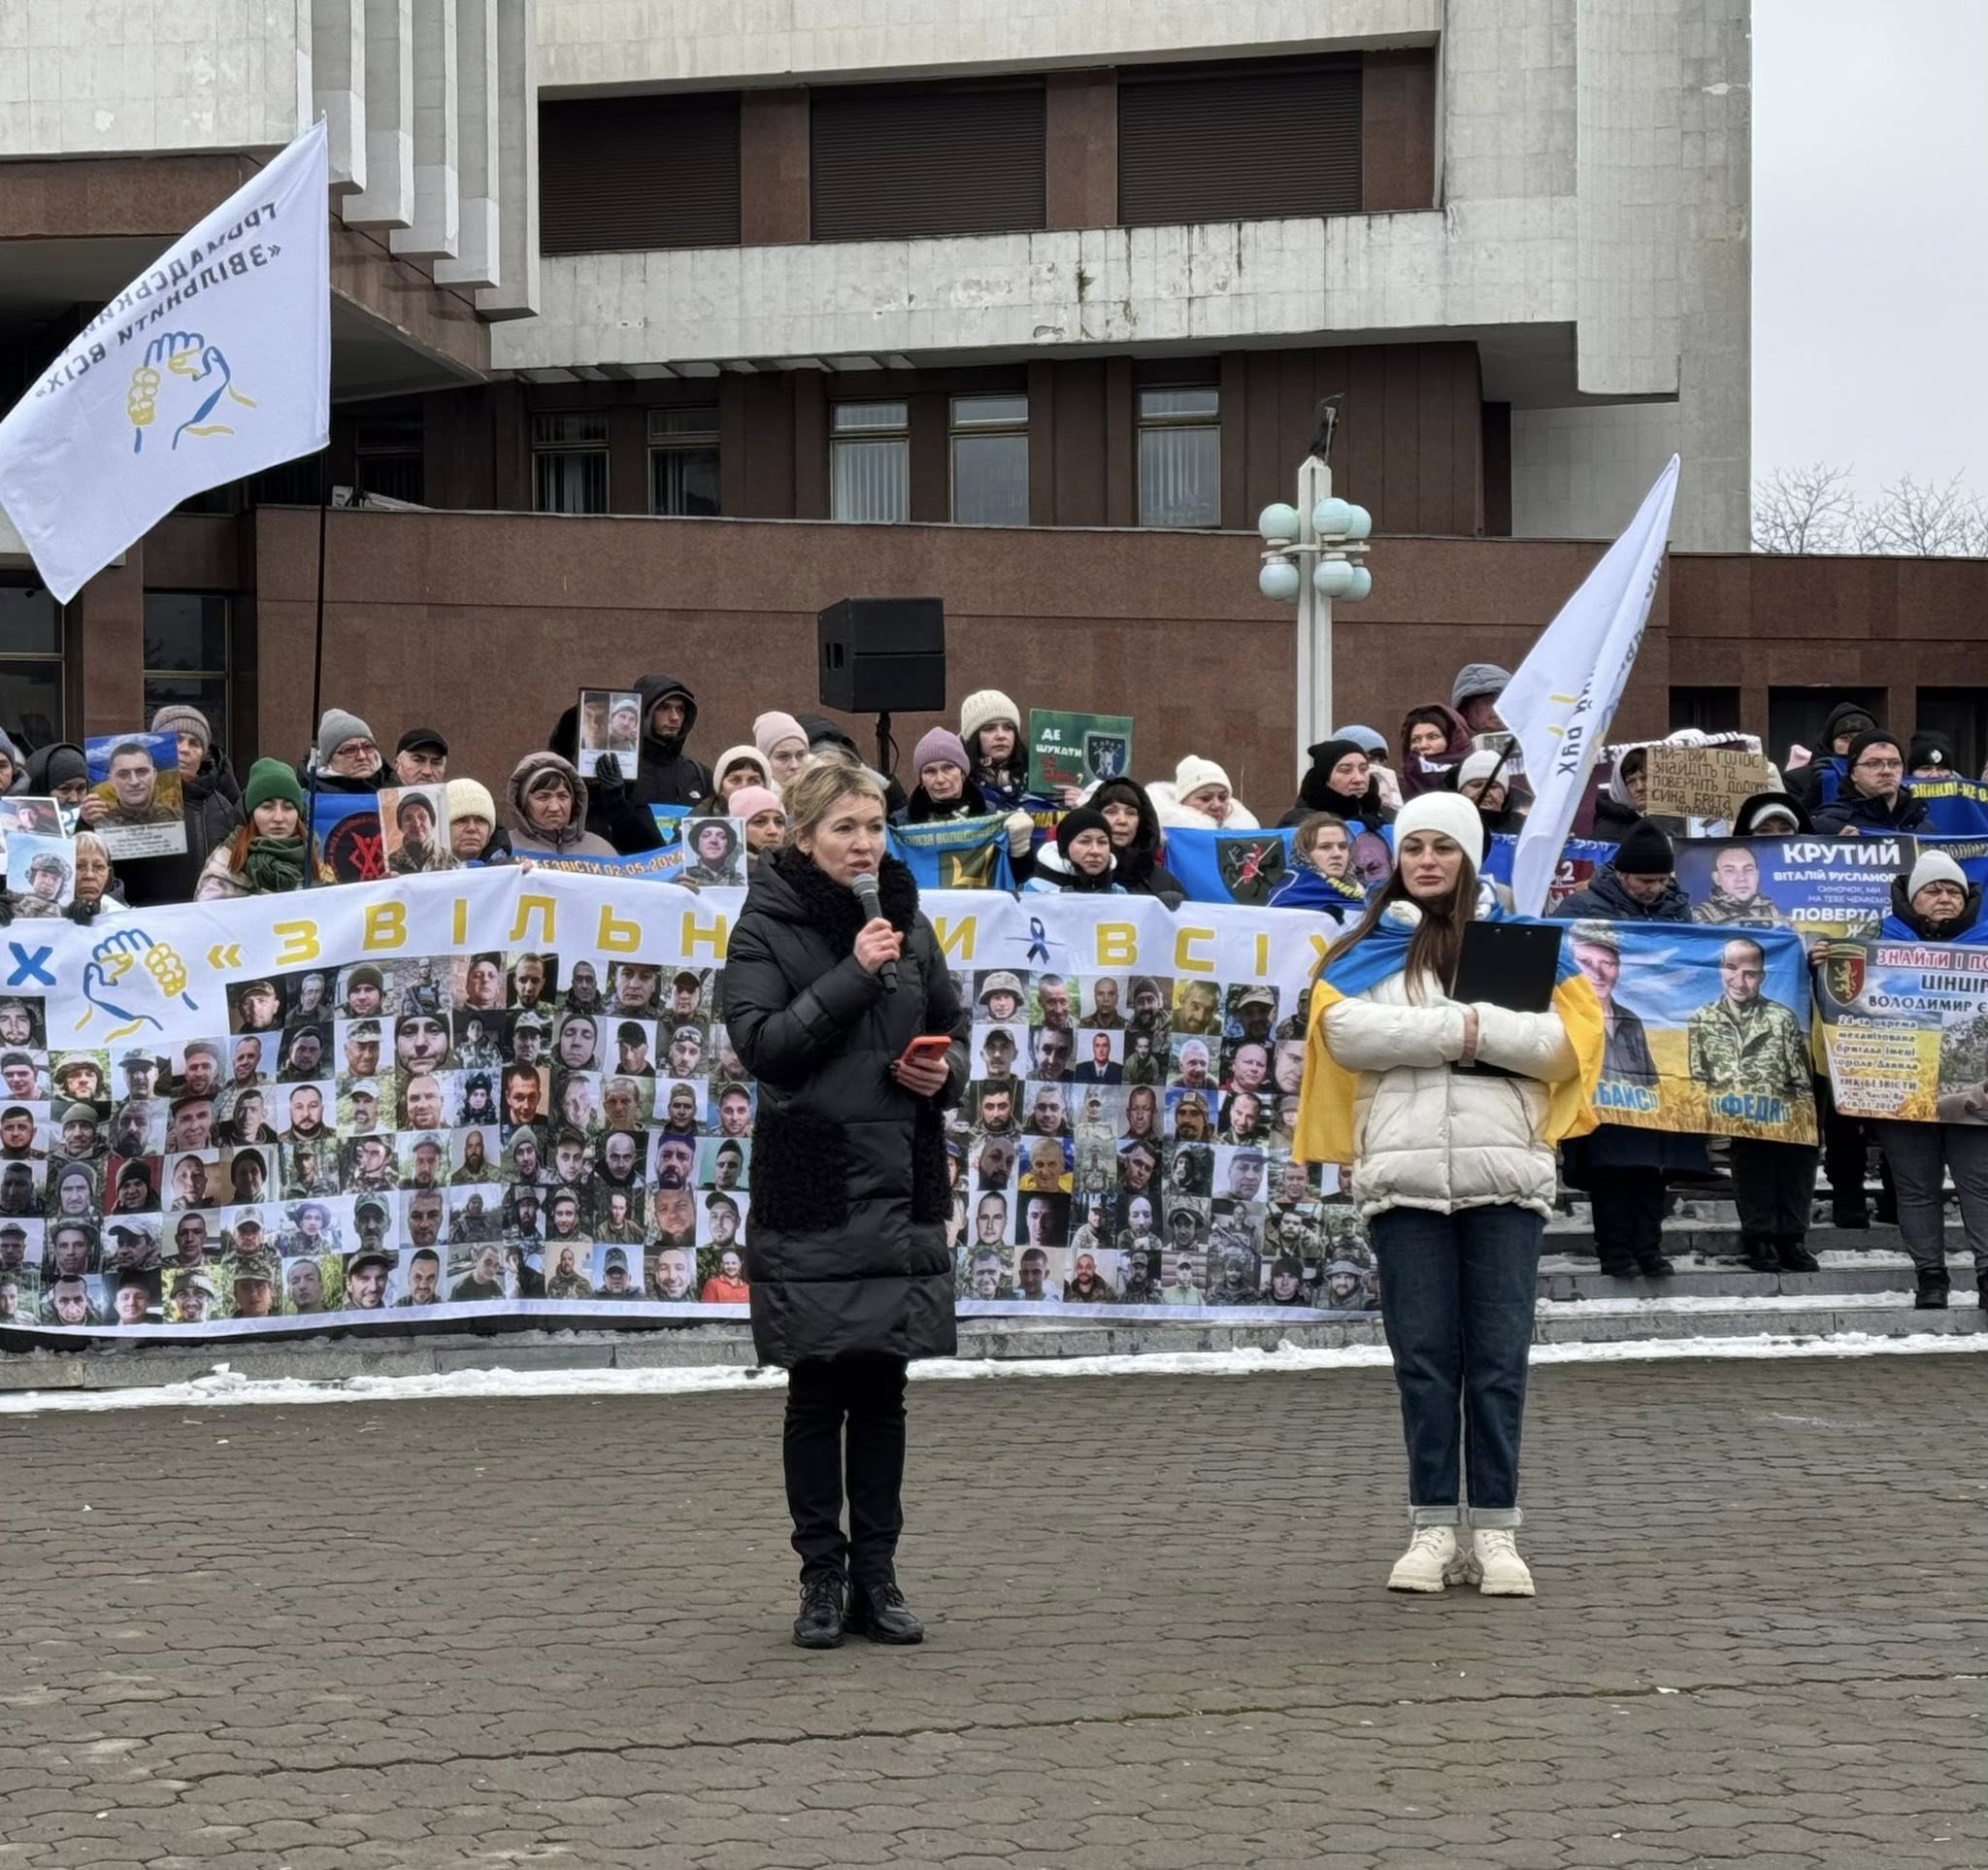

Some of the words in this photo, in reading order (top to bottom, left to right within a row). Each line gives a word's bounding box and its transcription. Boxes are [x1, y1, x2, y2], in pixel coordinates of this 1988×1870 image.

[1042, 728, 1061, 741] ДЕ
[1036, 744, 1082, 757] ШУКАТИ
[1782, 839, 1902, 866] КРУТИЙ
[1773, 869, 1827, 883] ВІТАЛІЙ
[207, 893, 977, 970] «ЗВІЛЬНИ
[1876, 949, 1950, 969] ЗНАЙТИ
[1955, 952, 1964, 969] І
[1869, 995, 1972, 1013] ВОЛОДИМИР
[1872, 1018, 1917, 1029] окрема
[1838, 1031, 1916, 1043] механізована
